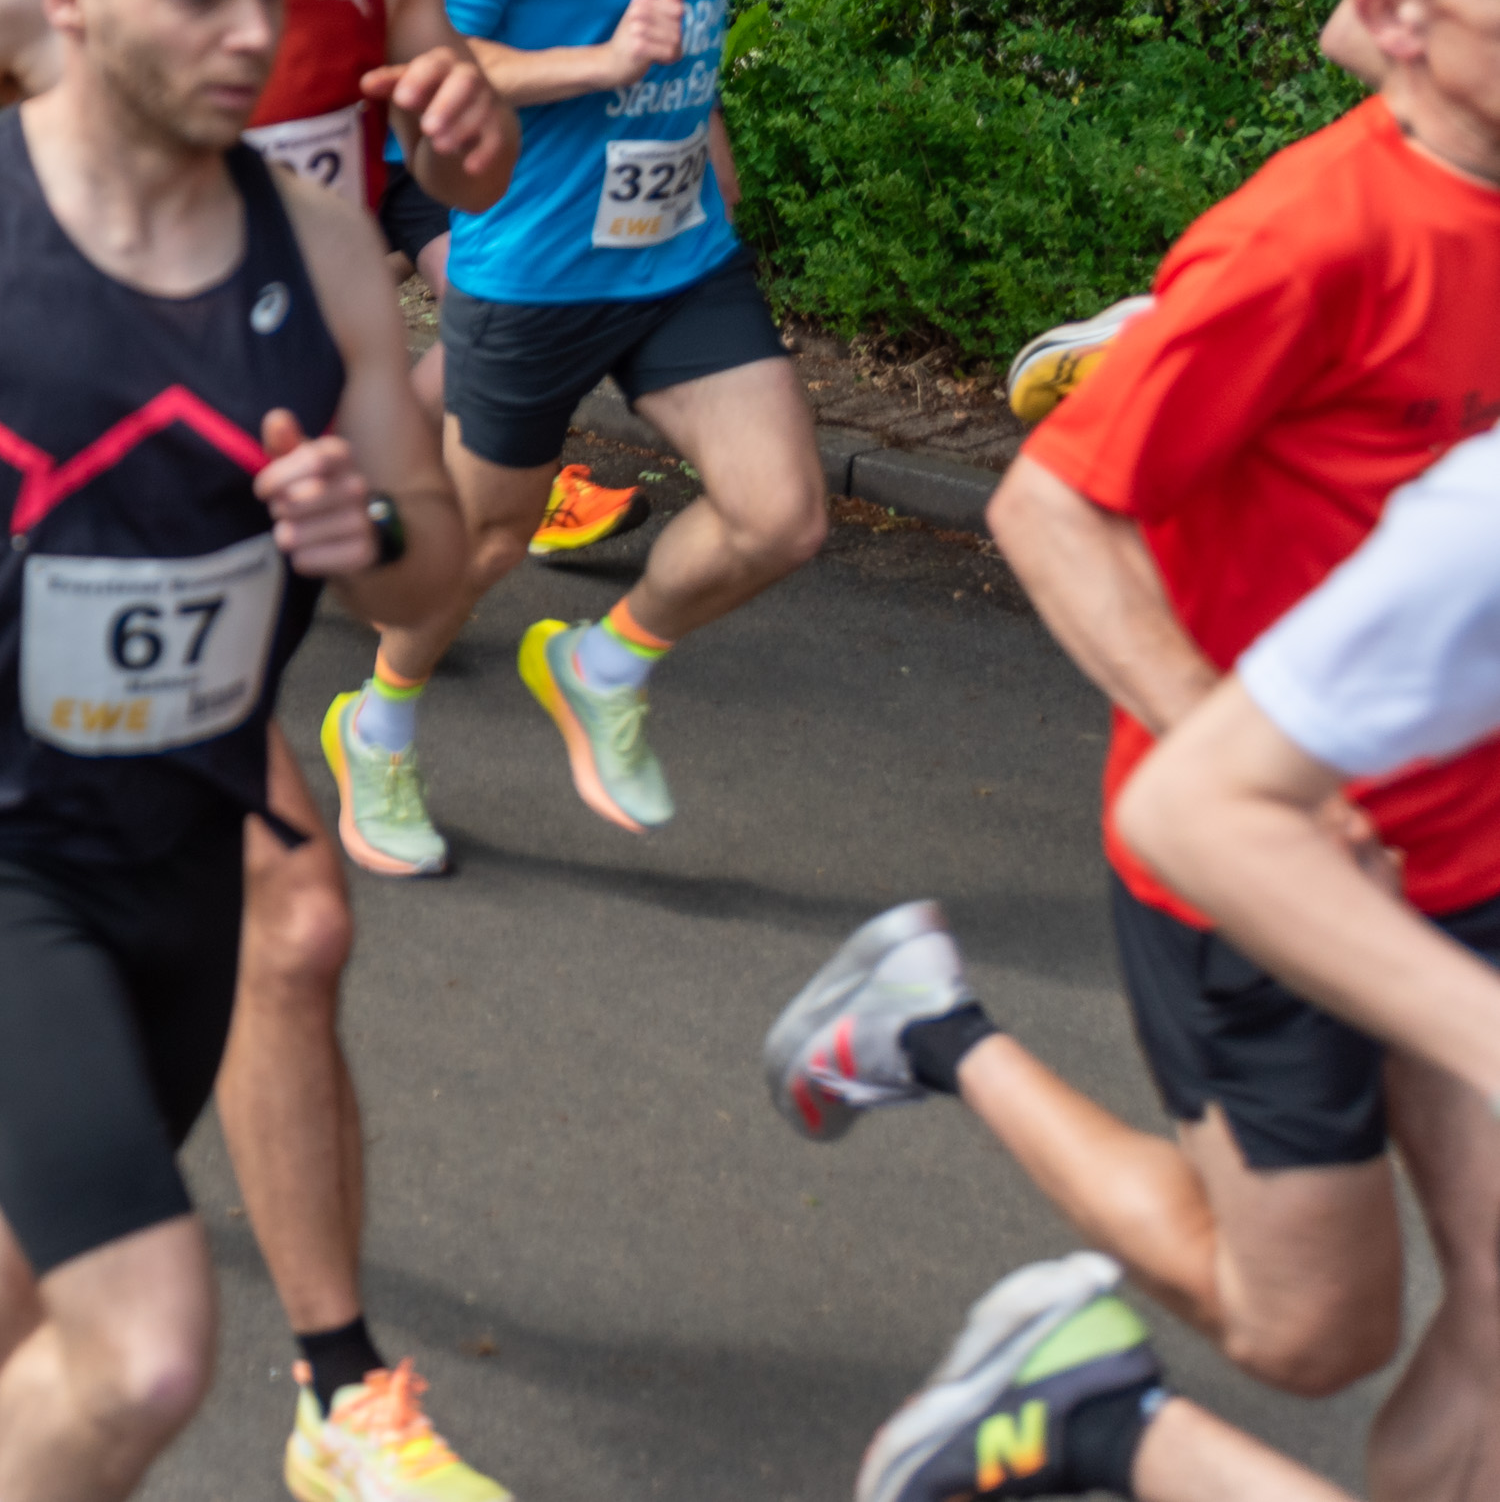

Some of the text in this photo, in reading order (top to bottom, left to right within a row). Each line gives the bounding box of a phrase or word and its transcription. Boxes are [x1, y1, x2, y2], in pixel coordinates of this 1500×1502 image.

[608, 215, 663, 236] EWE
[106, 594, 226, 673] 67
[51, 697, 150, 733] EWE
